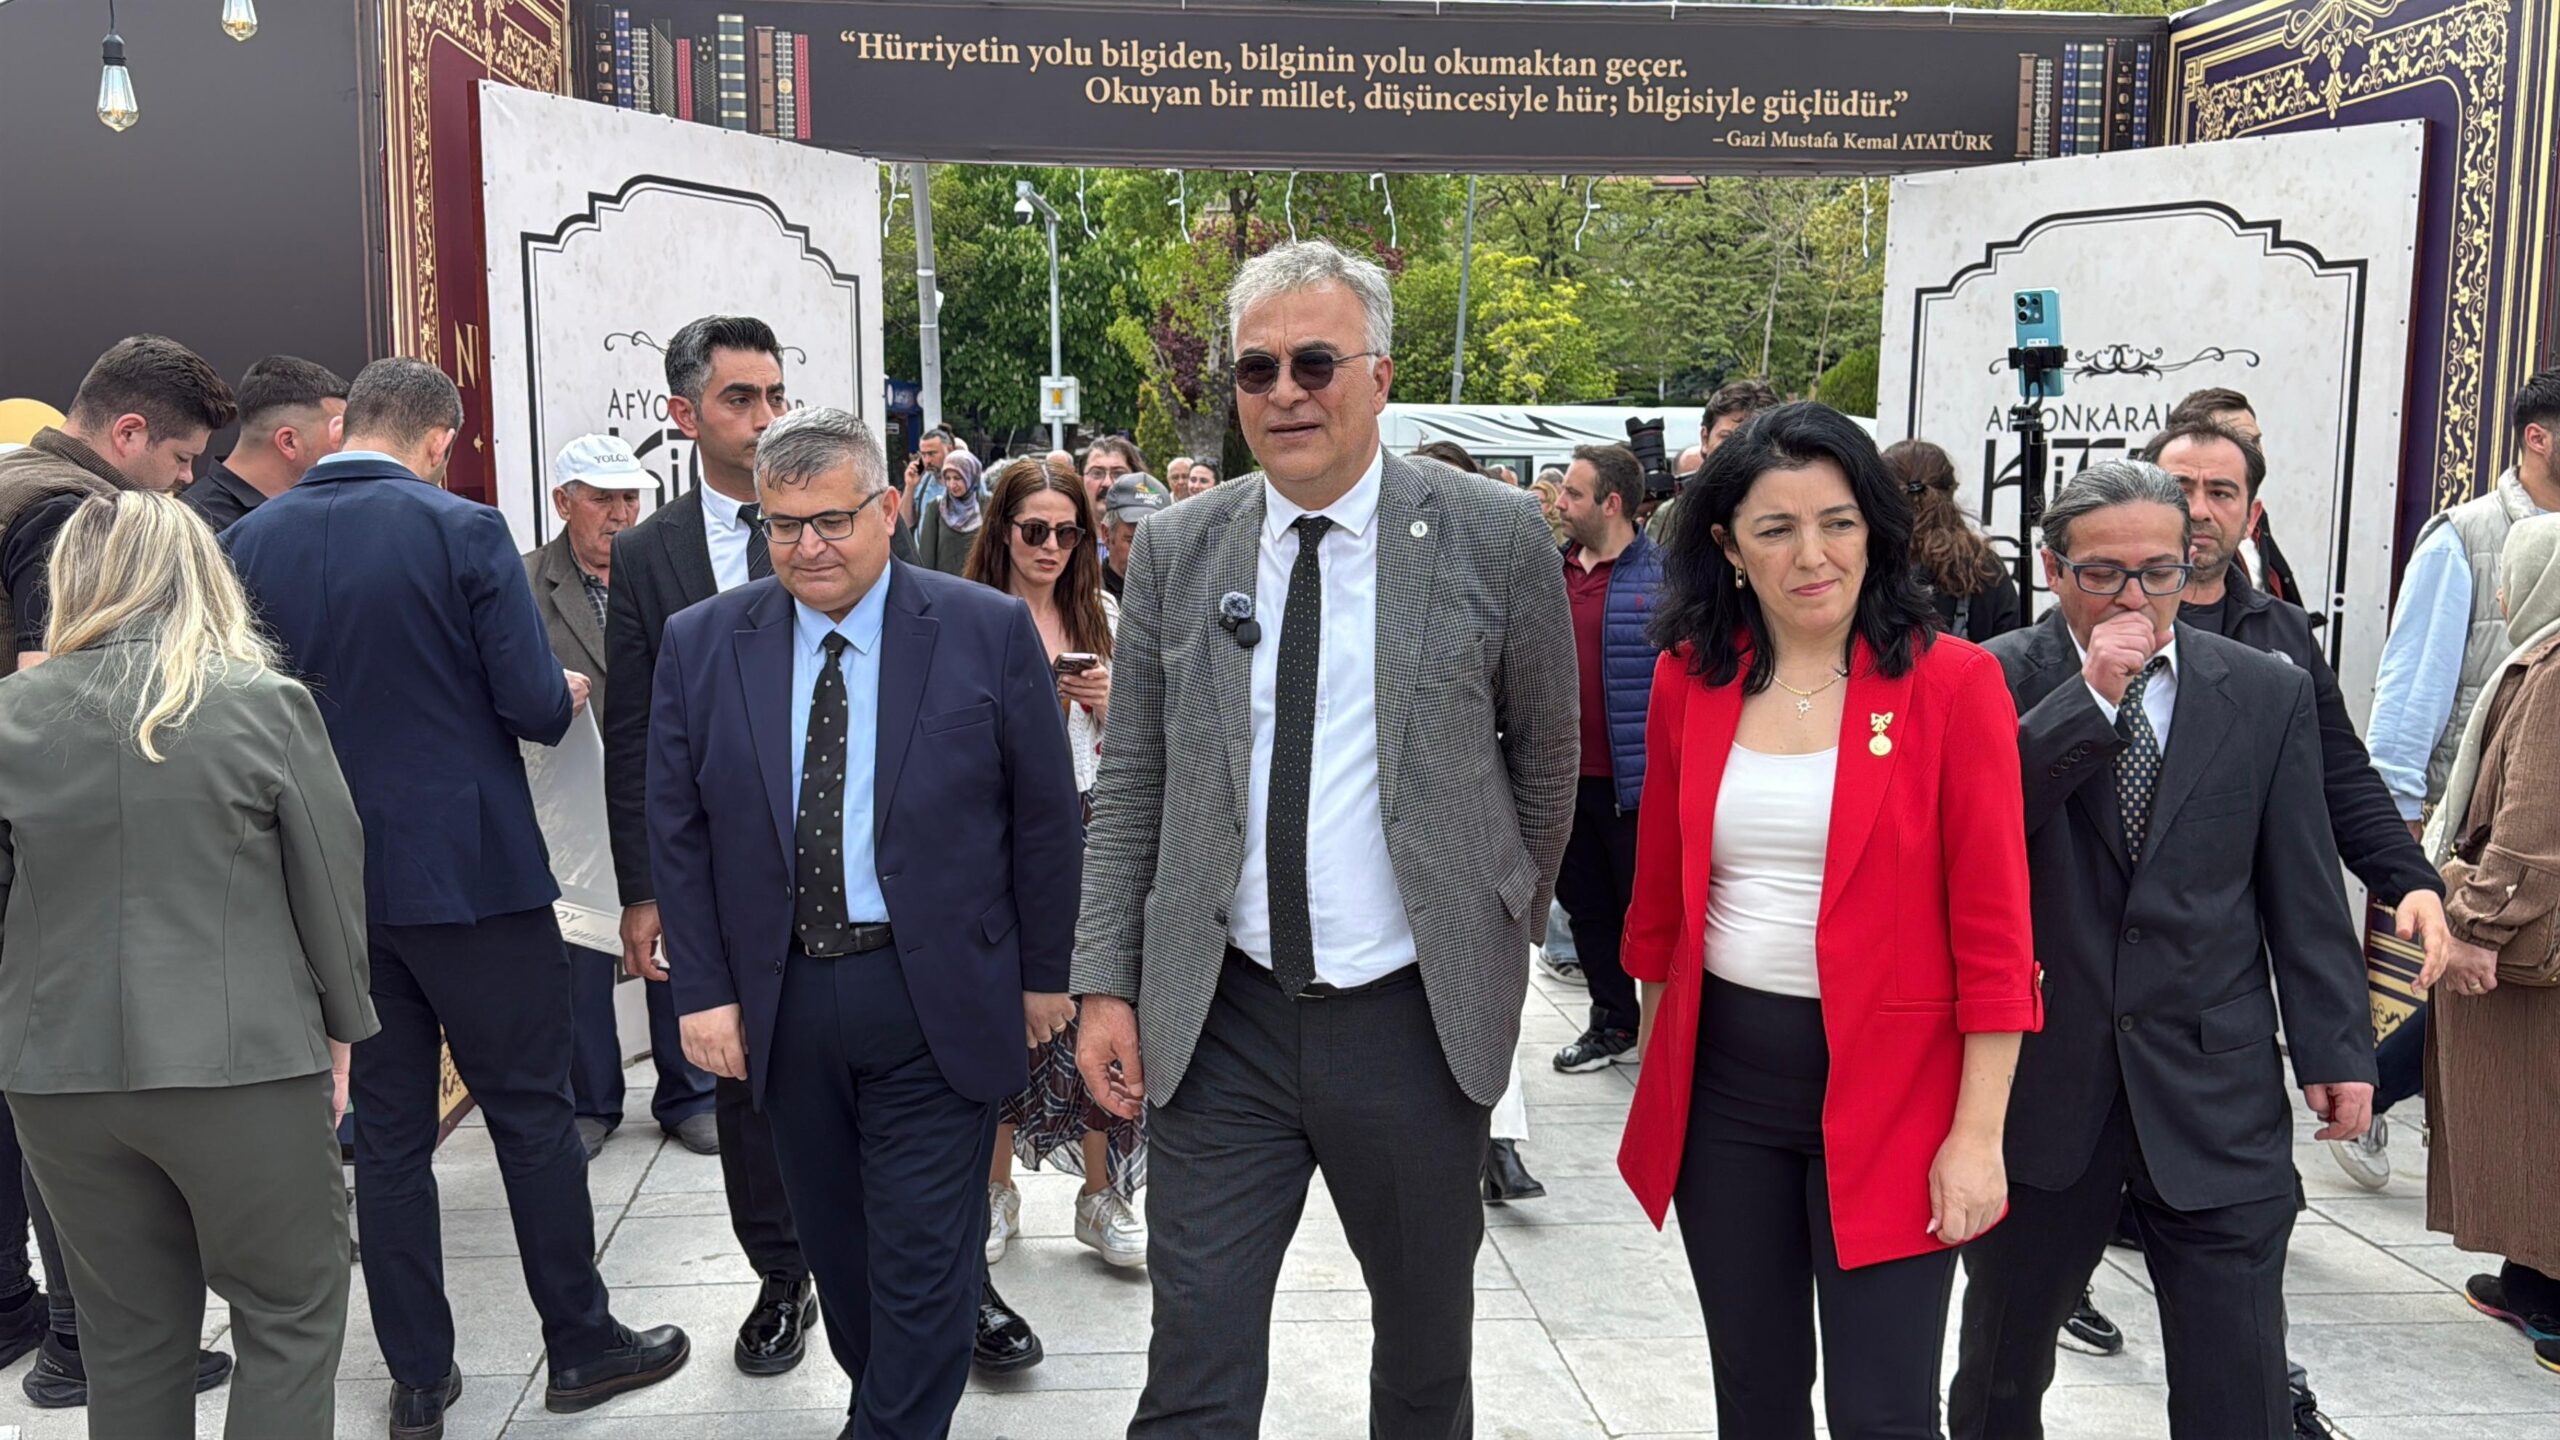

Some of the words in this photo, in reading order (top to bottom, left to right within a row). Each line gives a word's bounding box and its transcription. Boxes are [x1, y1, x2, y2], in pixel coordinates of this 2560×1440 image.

[840, 31, 1019, 70] “Hürriyetin
[1029, 38, 1094, 74] yolu
[1102, 40, 1233, 77] bilgiden,
[1241, 43, 1356, 81] bilginin
[1364, 47, 1425, 81] yolu
[1434, 47, 1598, 78] okumaktan
[1605, 58, 1688, 86] geçer.
[1085, 76, 1201, 113] Okuyan
[1211, 79, 1253, 108] bir
[1262, 80, 1357, 111] millet,
[1364, 82, 1550, 121] düşüncesiyle
[1557, 86, 1618, 117] hür;
[1627, 86, 1756, 123] bilgisiyle
[1763, 89, 1909, 123] güçlüdür.”
[1770, 132, 1839, 150] Mustafa
[1844, 132, 1899, 149] Kemal
[1901, 131, 1993, 151] ATATÜRK
